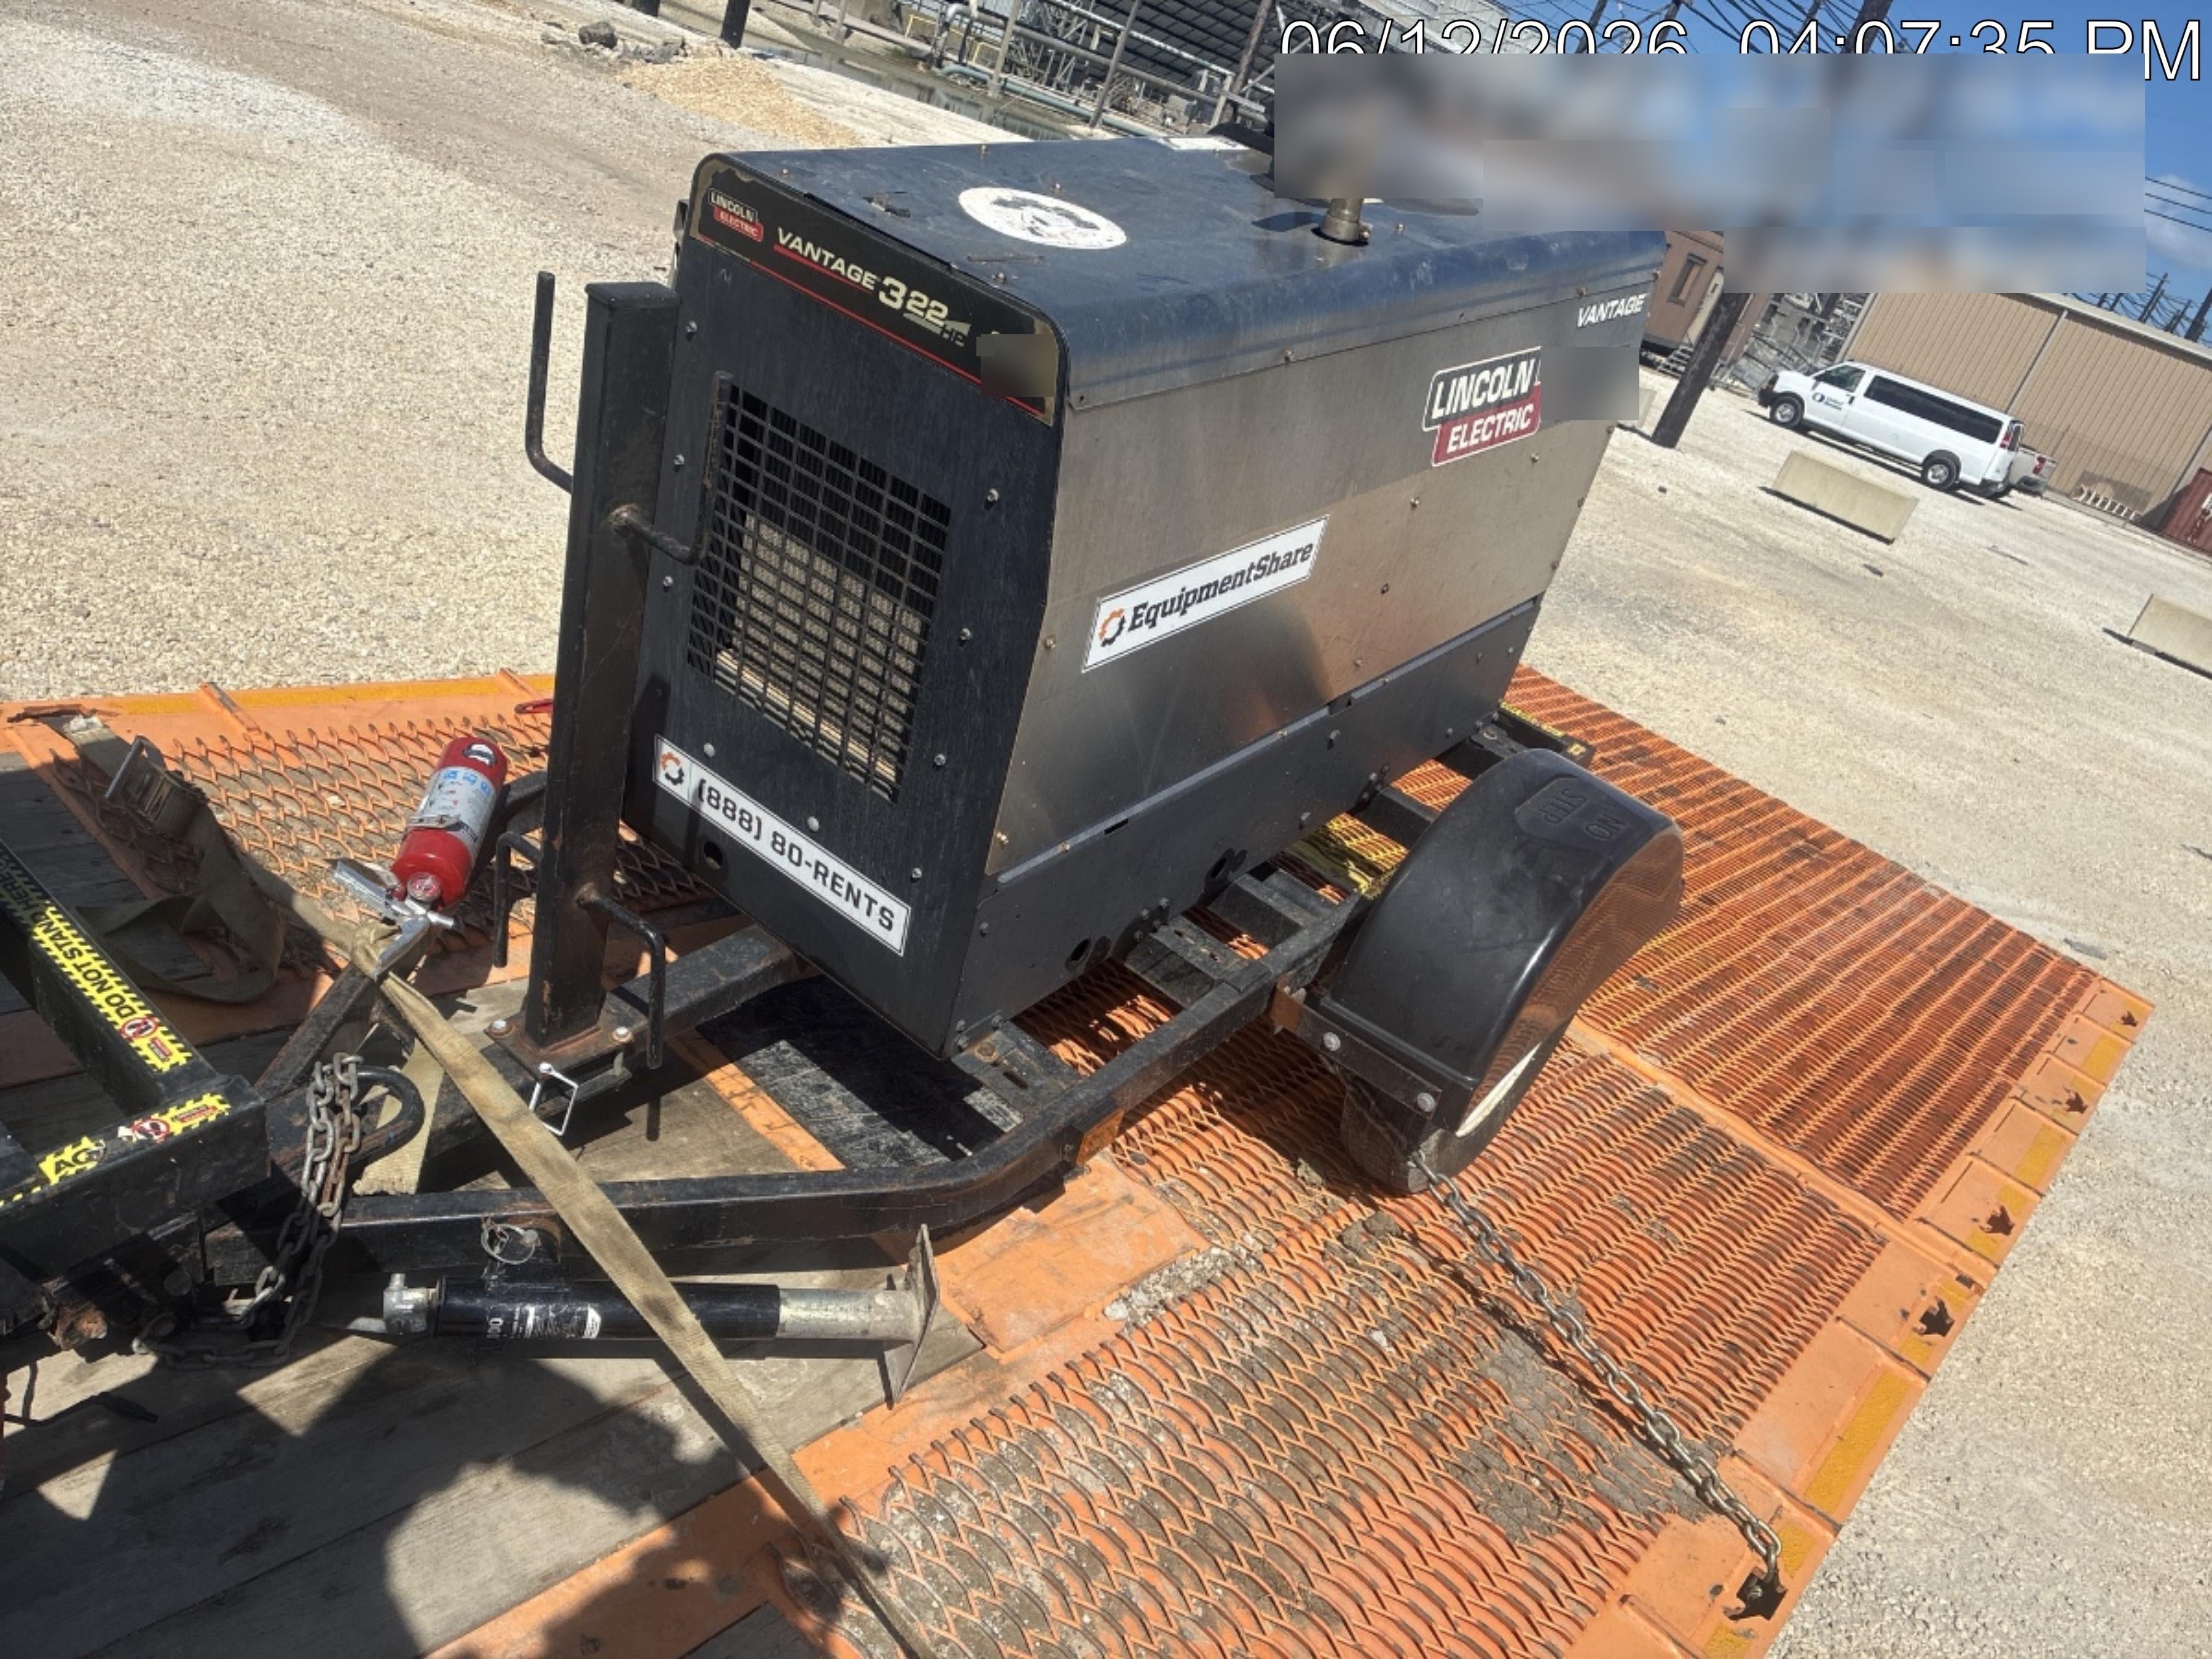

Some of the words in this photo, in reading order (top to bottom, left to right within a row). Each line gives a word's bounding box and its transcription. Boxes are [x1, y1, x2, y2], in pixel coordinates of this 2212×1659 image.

[711, 190, 754, 222] LINCOLN
[720, 210, 758, 238] ELECTRIC
[777, 226, 878, 291] VANTAGE
[879, 276, 949, 327] 322
[1577, 293, 1649, 327] VANTAGE
[1431, 358, 1535, 419] LINCOLN
[1446, 403, 1534, 455] ELECTRIC
[1128, 543, 1314, 632] EquipmentShare
[697, 778, 763, 841] (888)
[770, 829, 895, 931] 80-RENTS
[29, 911, 83, 960] STAND
[72, 962, 114, 994] NOT
[104, 993, 136, 1019] DO
